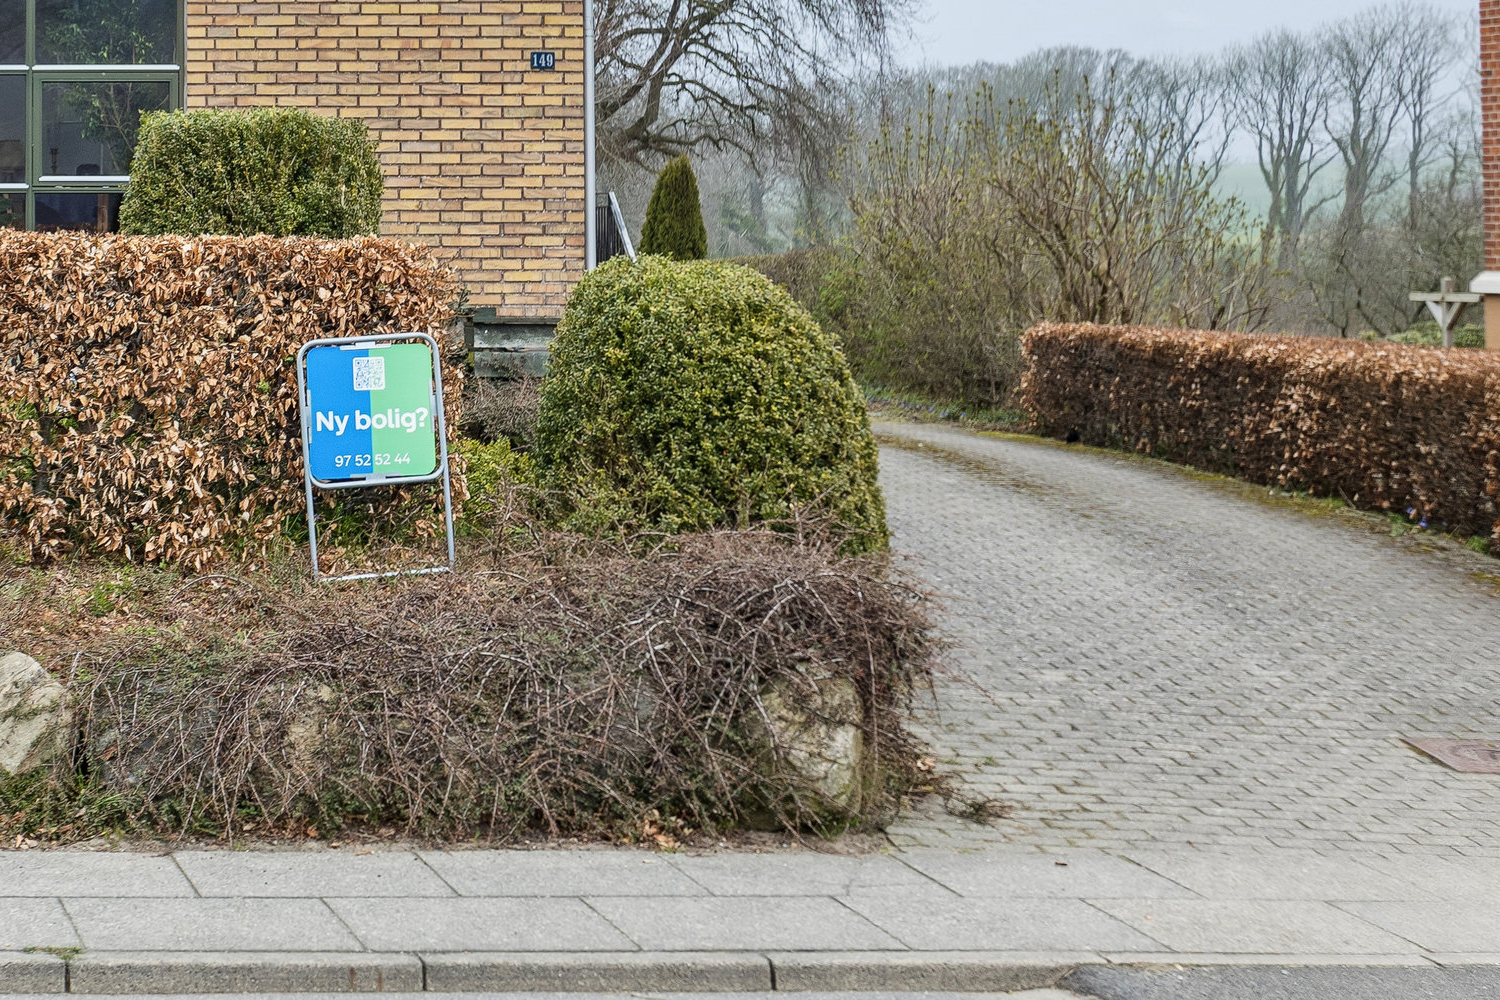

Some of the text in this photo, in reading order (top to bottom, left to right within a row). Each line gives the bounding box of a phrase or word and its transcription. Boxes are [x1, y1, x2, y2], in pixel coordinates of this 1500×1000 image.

[533, 53, 553, 67] 149
[315, 407, 429, 436] Ny bolig?
[334, 452, 411, 468] 97 52 52 44
